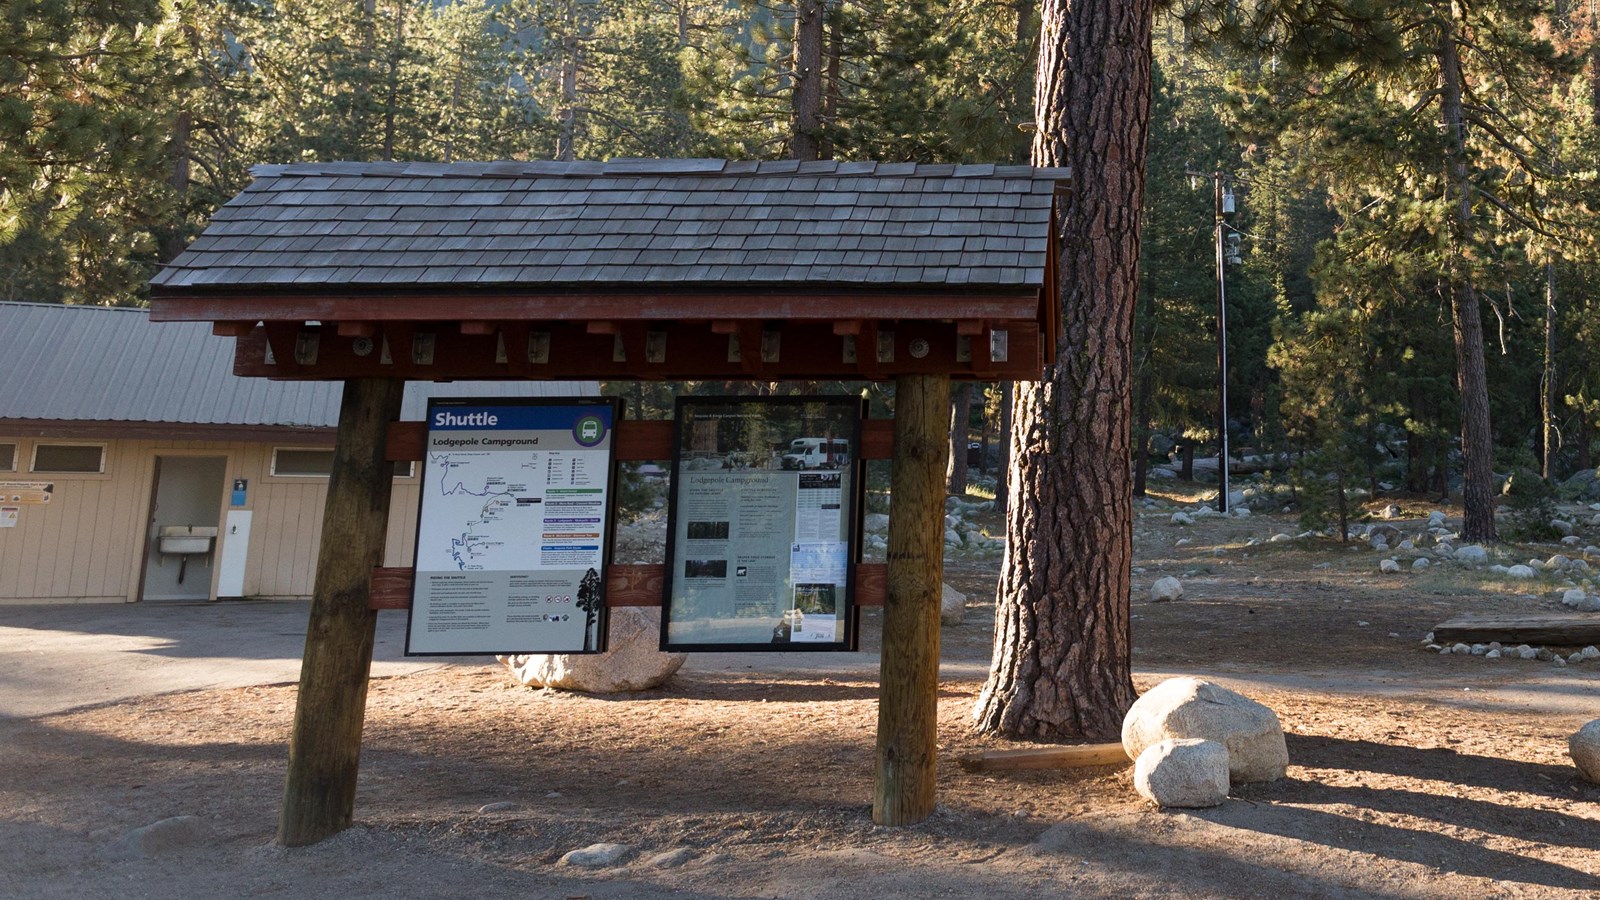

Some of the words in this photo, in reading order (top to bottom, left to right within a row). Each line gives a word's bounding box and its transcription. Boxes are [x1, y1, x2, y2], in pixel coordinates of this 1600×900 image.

[434, 411, 498, 426] Shuttle
[433, 437, 479, 447] Lodgepole
[481, 437, 539, 447] Campground
[690, 476, 724, 485] Lodgepole
[725, 476, 769, 485] Campground
